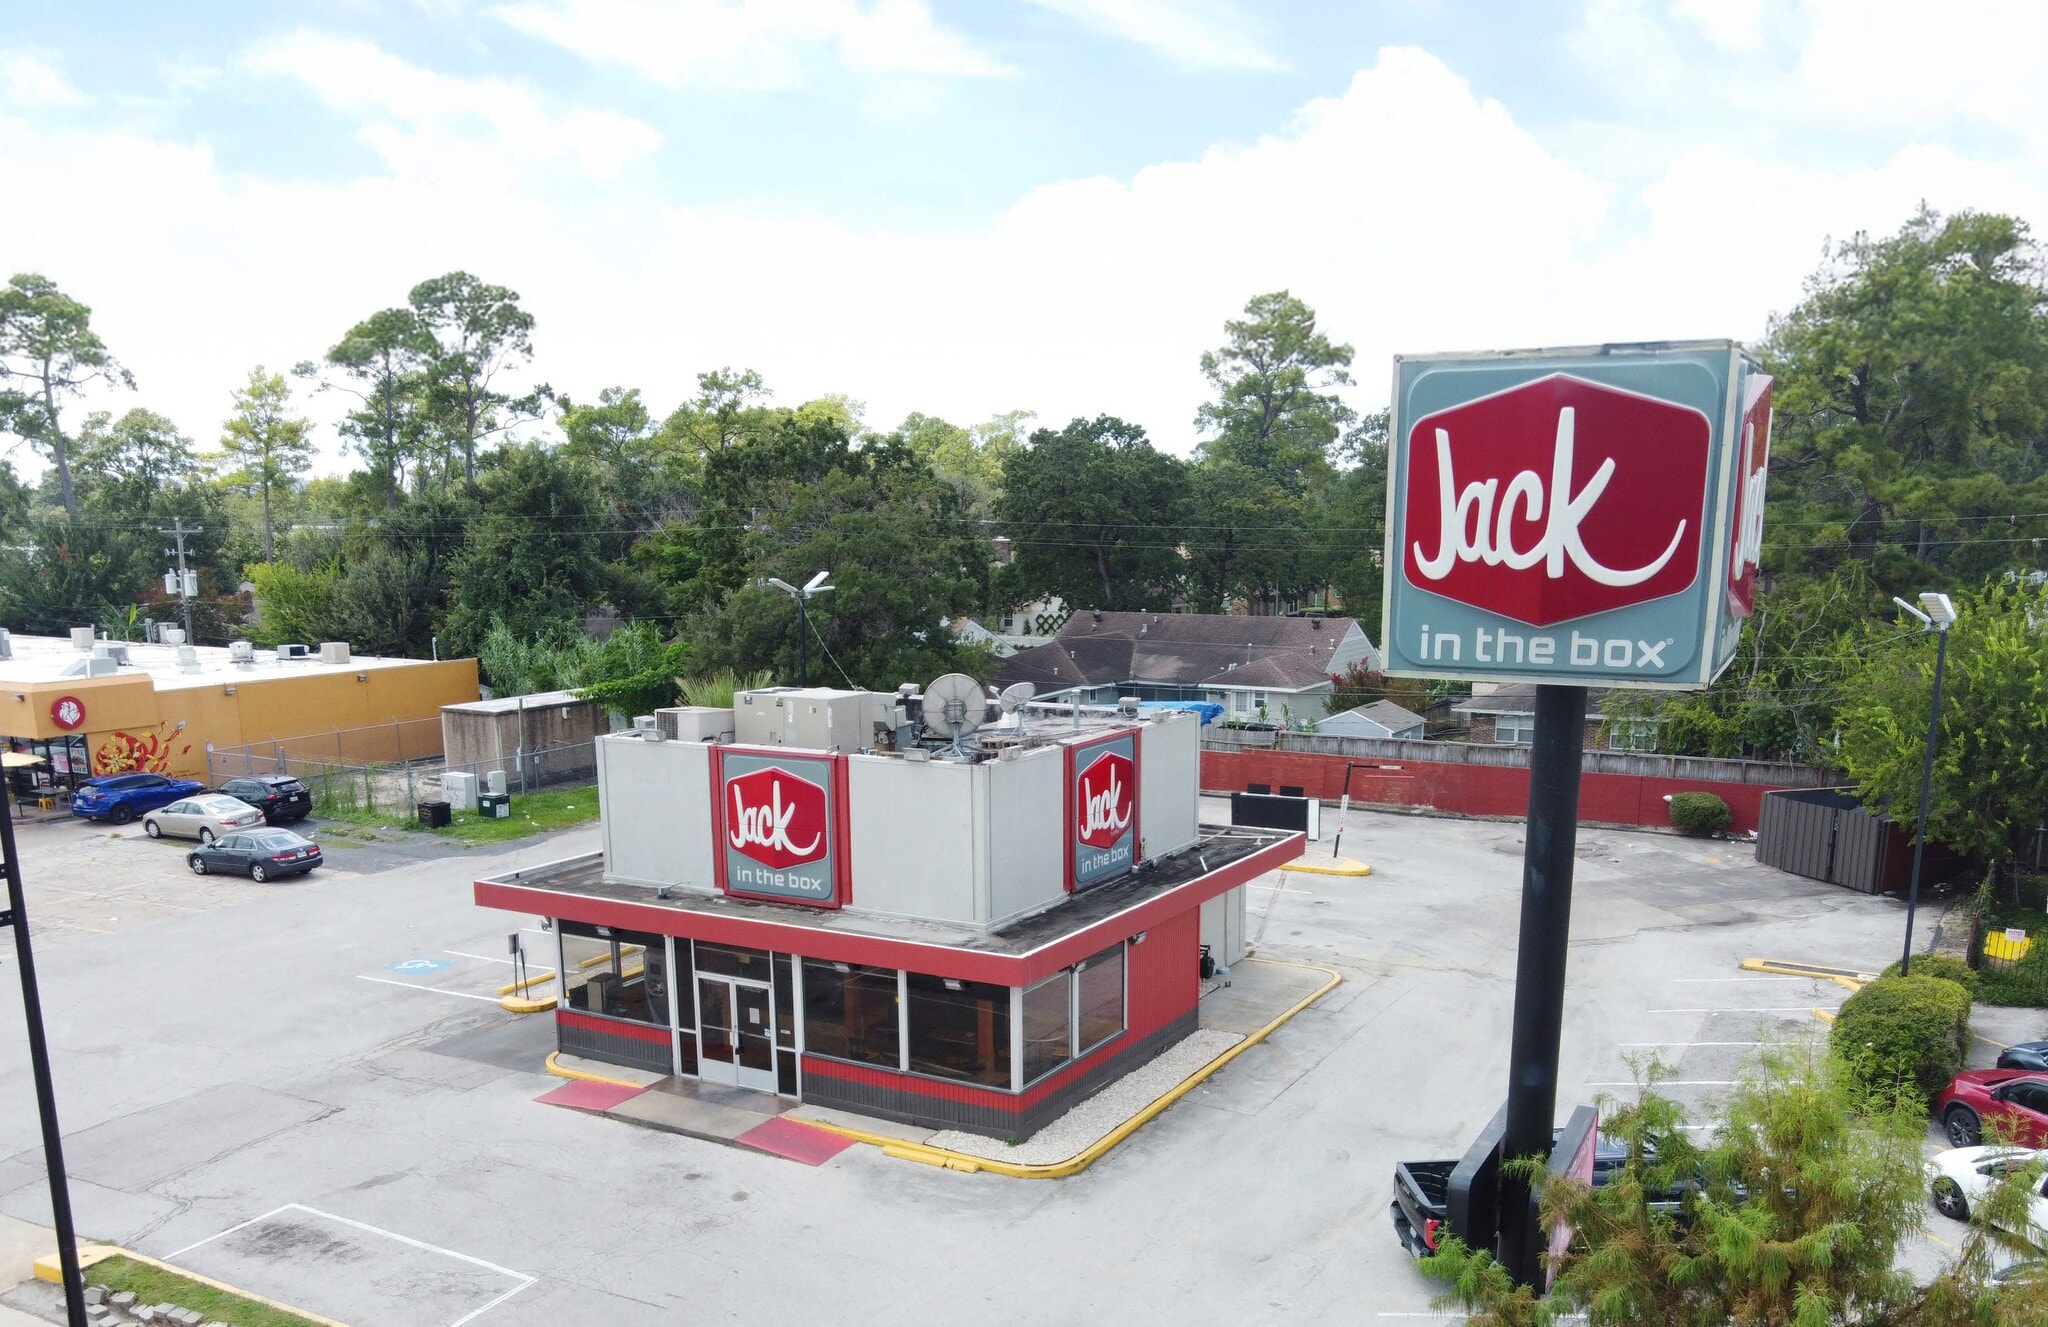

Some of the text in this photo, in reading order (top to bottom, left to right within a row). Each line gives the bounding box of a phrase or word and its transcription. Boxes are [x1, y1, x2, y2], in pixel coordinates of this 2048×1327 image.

[1413, 407, 1687, 587] Jack
[1420, 624, 1666, 668] in the box
[731, 781, 821, 856] Jack
[1081, 763, 1132, 840] Jack
[737, 866, 821, 891] in the box
[1081, 846, 1129, 874] in the box
